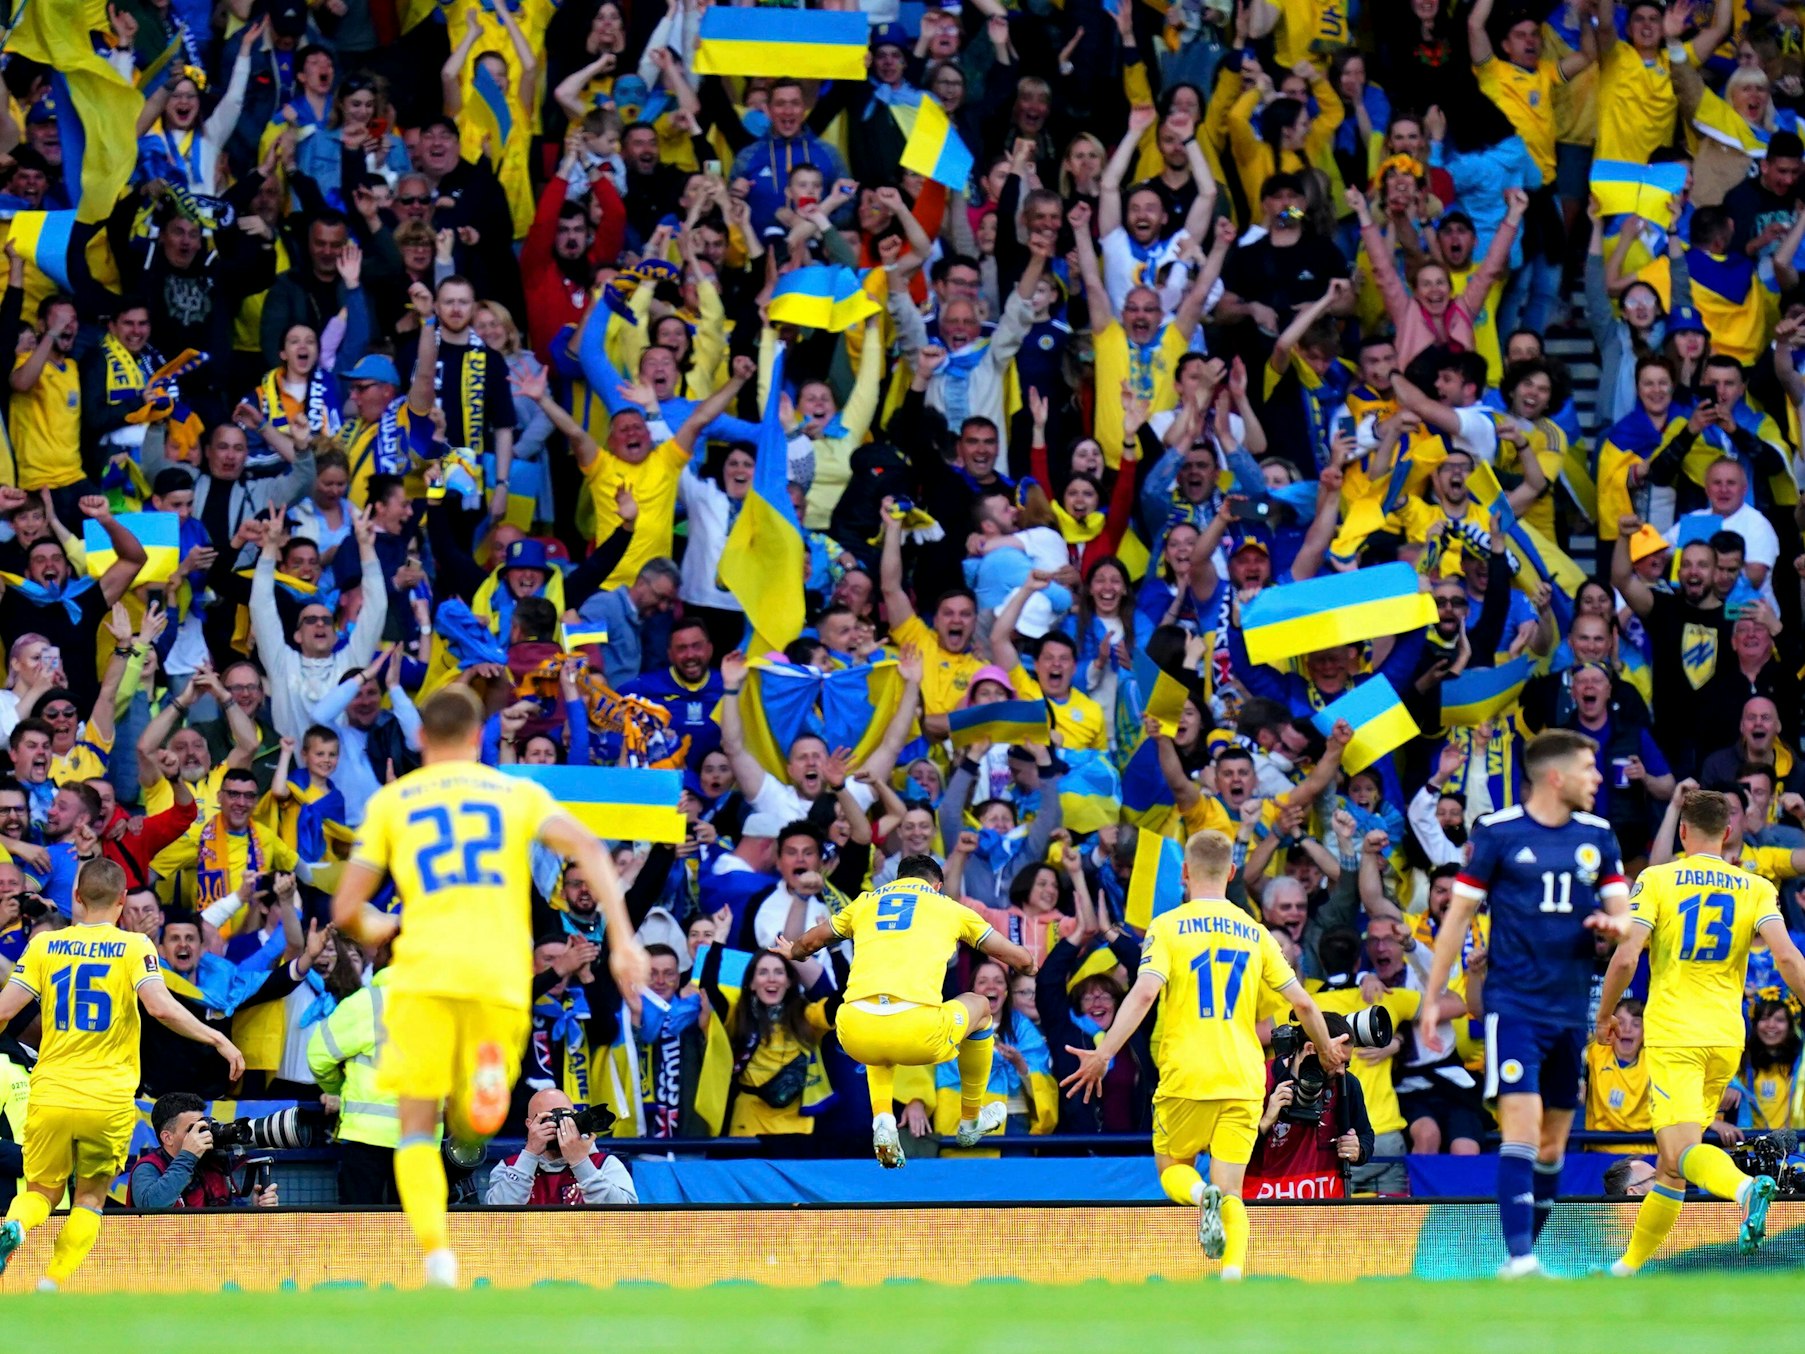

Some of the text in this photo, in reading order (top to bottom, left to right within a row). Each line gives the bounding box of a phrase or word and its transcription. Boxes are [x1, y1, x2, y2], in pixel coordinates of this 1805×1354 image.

[407, 802, 505, 894] 22
[875, 893, 919, 931] 9
[1538, 871, 1574, 914] 11
[47, 940, 127, 958] MYKOLENKO
[1177, 916, 1260, 943] ZINCHENKO
[1678, 892, 1735, 962] 13
[51, 963, 112, 1032] 16
[1190, 947, 1250, 1020] 17
